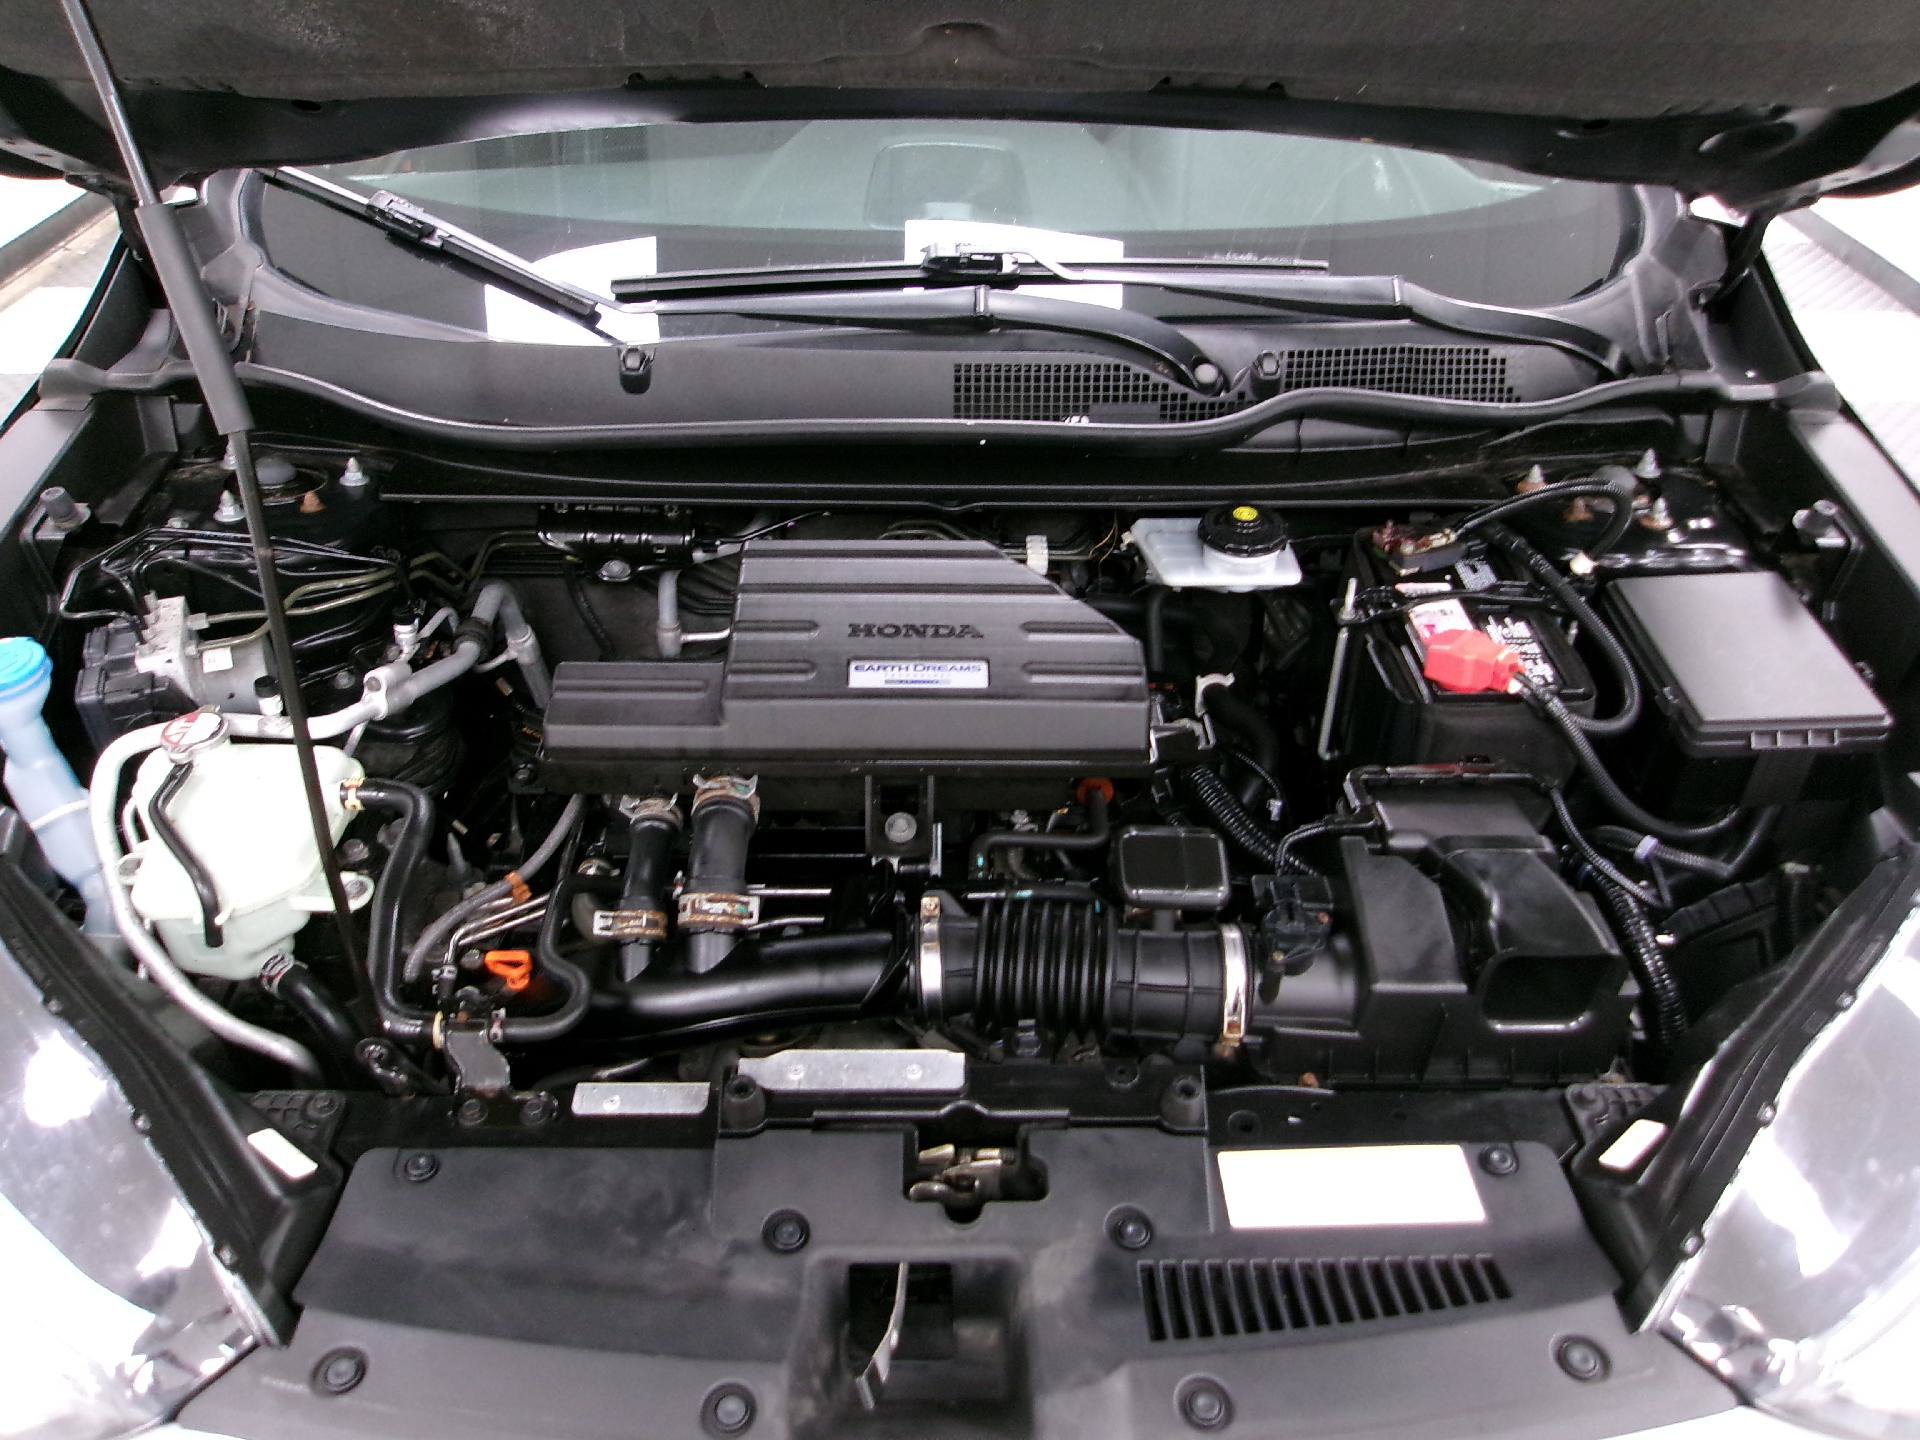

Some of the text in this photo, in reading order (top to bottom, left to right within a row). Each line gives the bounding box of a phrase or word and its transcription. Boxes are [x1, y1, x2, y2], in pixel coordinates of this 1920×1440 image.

[848, 623, 984, 638] HONDA
[854, 664, 982, 672] EARTH DREAMS
